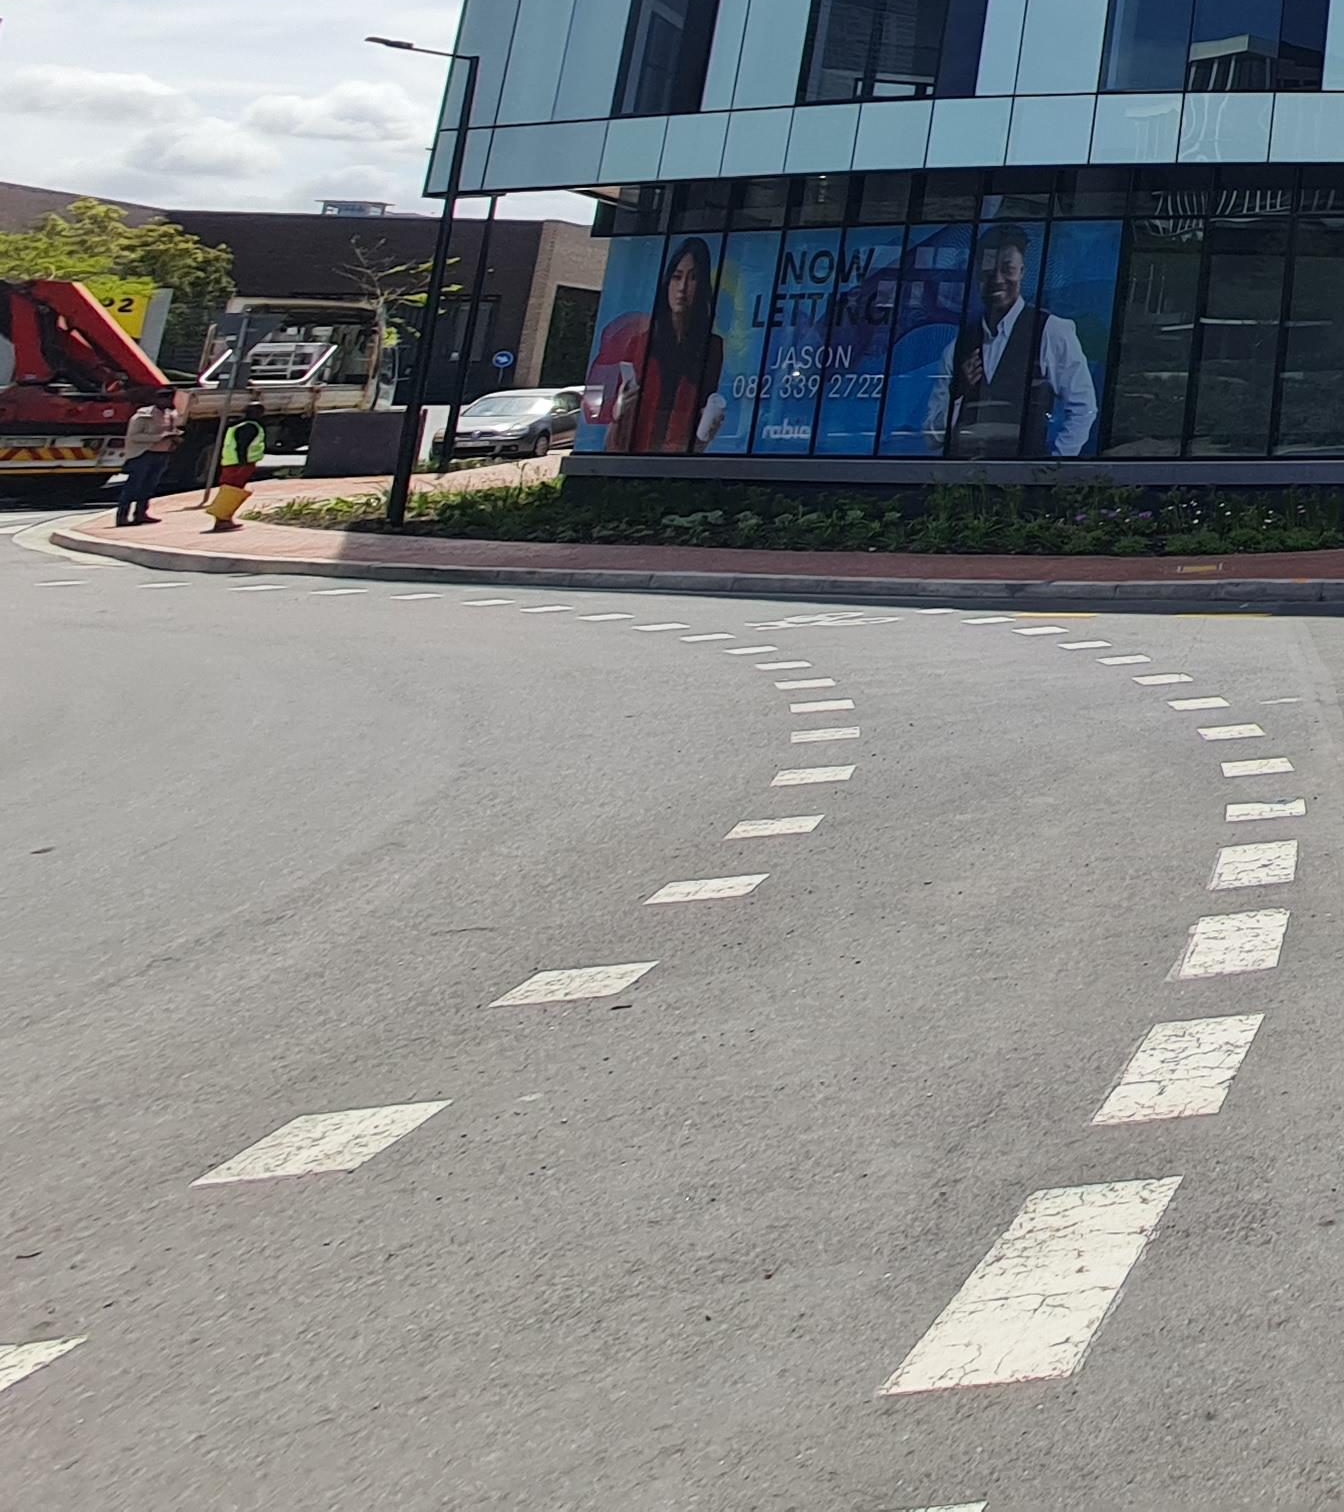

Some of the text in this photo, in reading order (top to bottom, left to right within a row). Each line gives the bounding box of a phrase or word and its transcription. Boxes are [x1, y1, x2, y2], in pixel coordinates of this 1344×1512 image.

[781, 248, 876, 285] NOW
[752, 292, 892, 328] LETTING
[770, 344, 853, 370] JASON
[732, 374, 885, 399] 082 339 2722
